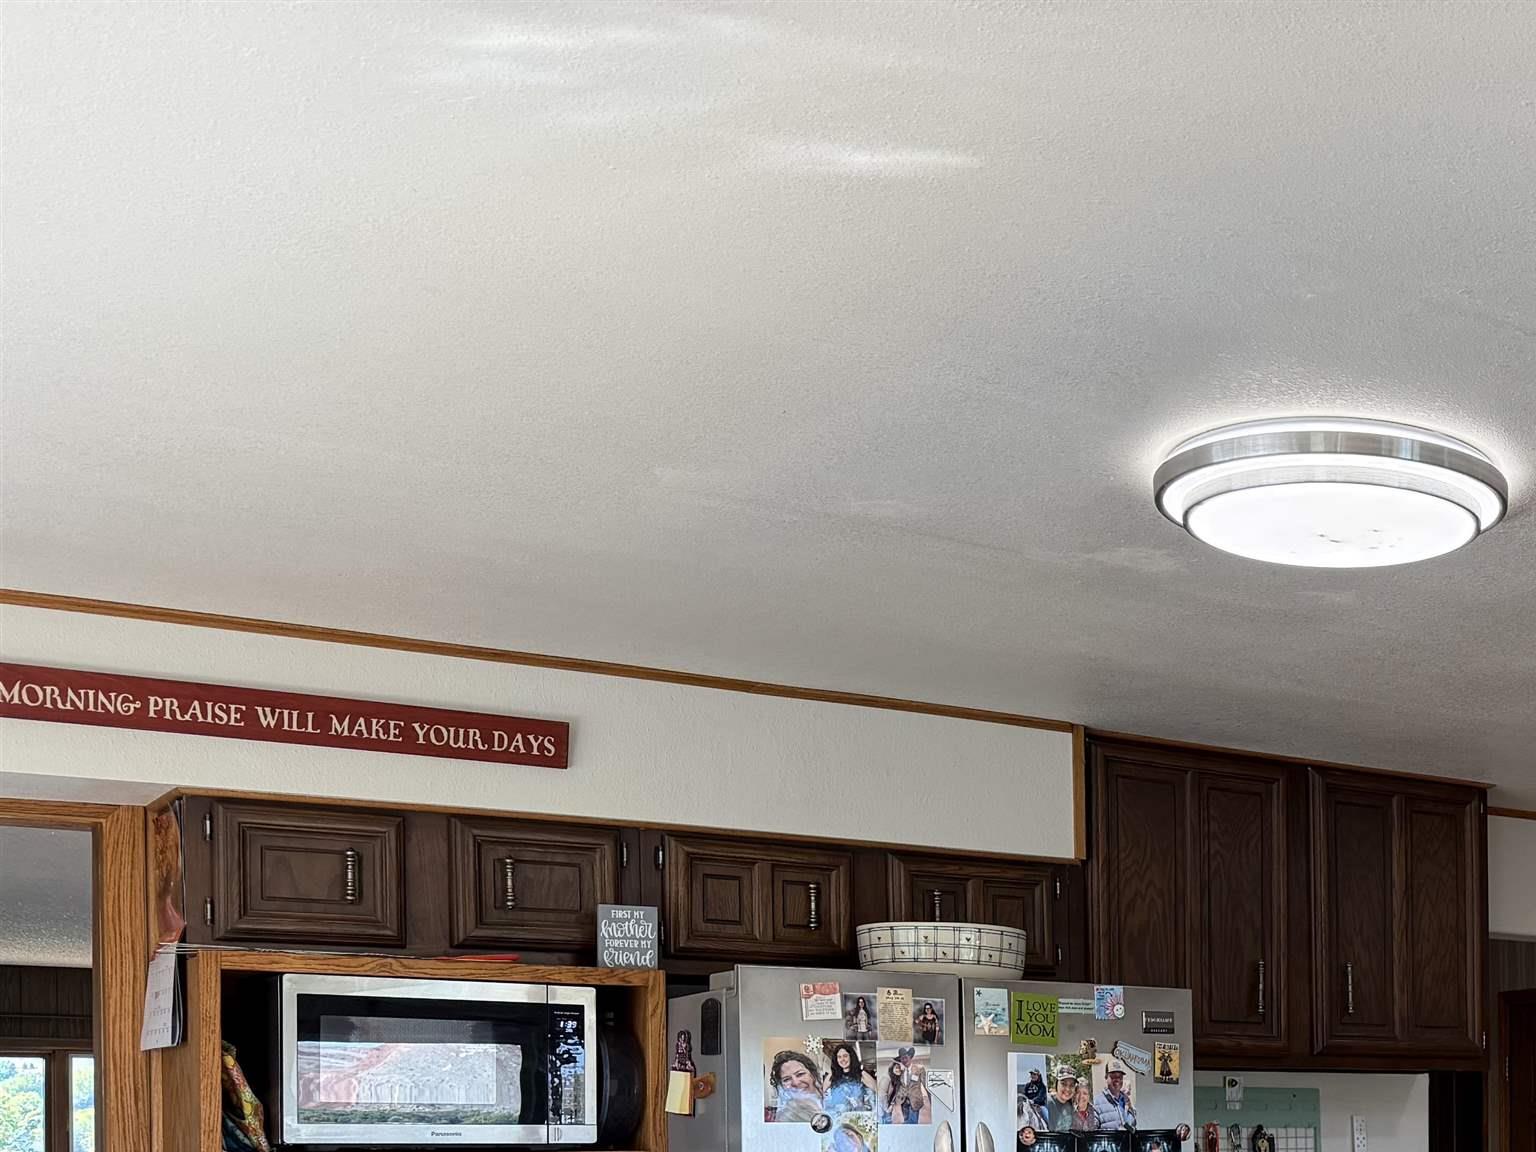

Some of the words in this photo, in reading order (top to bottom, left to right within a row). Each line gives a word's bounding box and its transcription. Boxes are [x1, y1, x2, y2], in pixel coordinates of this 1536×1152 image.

[0, 680, 142, 716] MORNING
[148, 695, 247, 727] PRAISE
[254, 706, 321, 734] WILL
[328, 713, 405, 742] MAKE
[411, 721, 488, 751] YOUR
[491, 730, 557, 757] DAYS
[611, 910, 631, 918] FIRST
[633, 911, 644, 919] MY
[605, 939, 638, 947] FOREVER
[640, 940, 652, 948] MY
[1015, 999, 1025, 1022] I
[1026, 1001, 1057, 1013] LOVE
[1026, 1012, 1056, 1025] YOU
[1015, 1022, 1055, 1038] MOM
